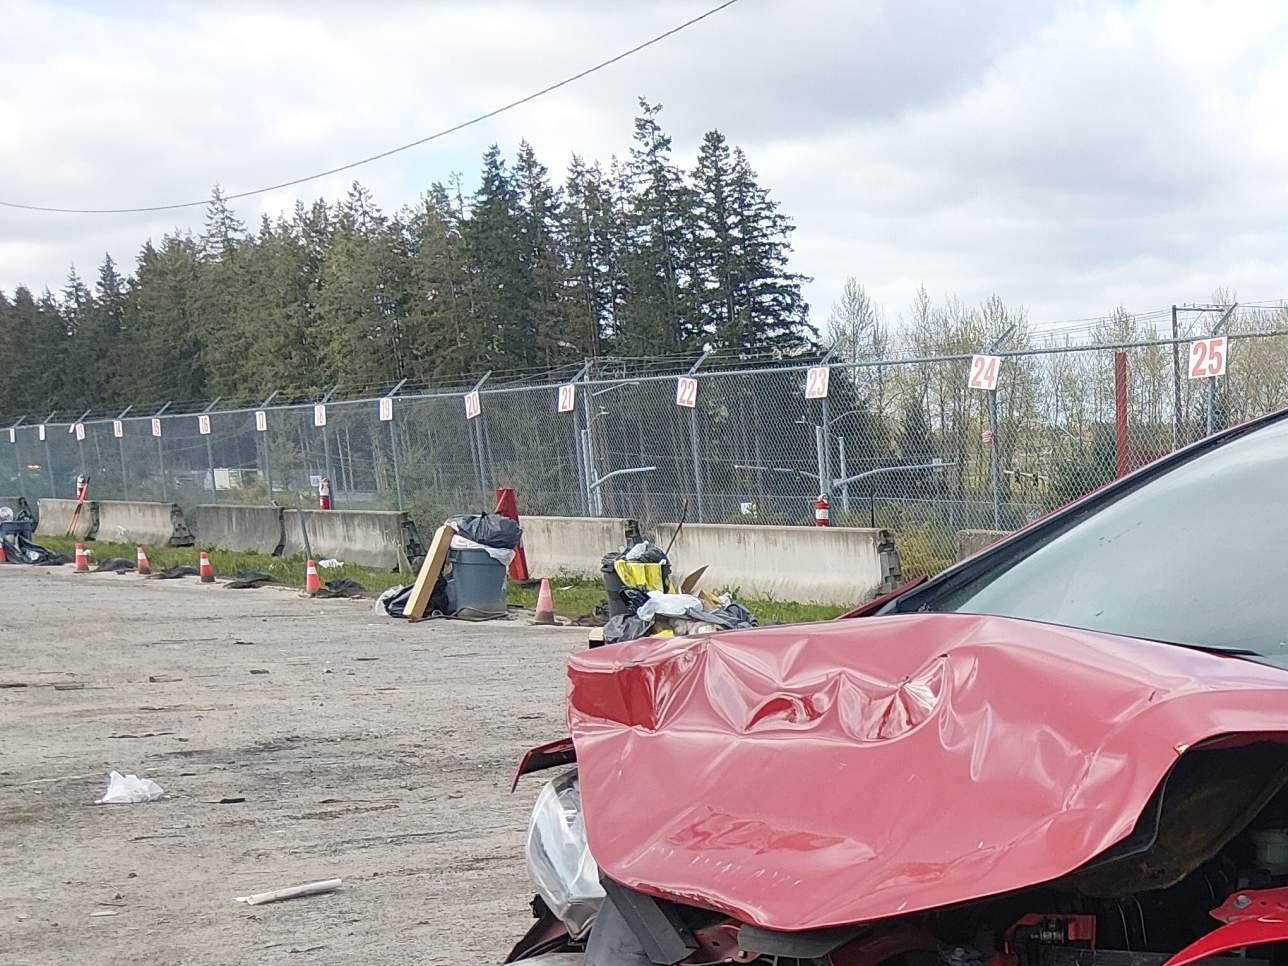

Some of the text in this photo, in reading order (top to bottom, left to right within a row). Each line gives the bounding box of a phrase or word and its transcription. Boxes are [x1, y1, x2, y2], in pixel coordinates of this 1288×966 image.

[1191, 339, 1224, 376] 25
[807, 368, 827, 396] 23
[970, 356, 997, 388] 24
[561, 387, 572, 410] 21
[678, 380, 696, 404] 22
[382, 398, 391, 419] 19
[466, 393, 479, 417] 20
